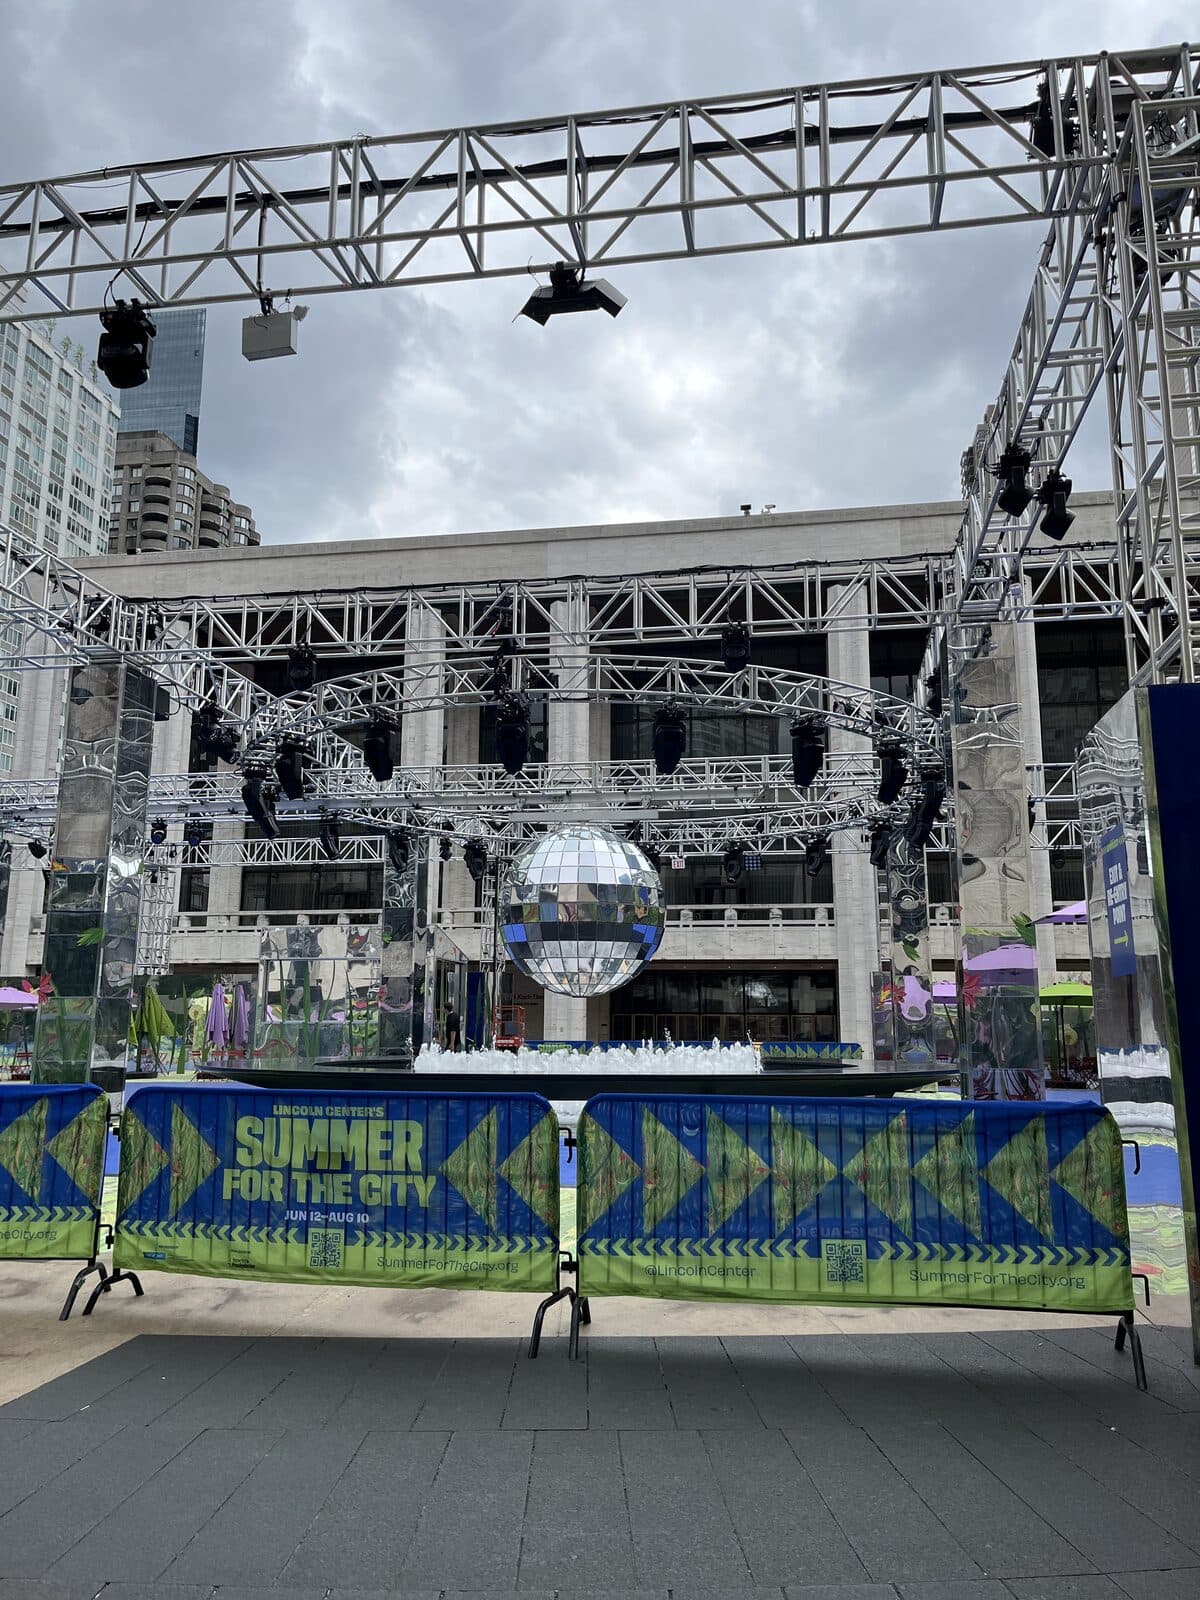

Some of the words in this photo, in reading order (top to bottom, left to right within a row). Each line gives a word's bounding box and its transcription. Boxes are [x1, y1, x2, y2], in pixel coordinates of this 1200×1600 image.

[673, 860, 684, 868] EXIT
[272, 1105, 323, 1117] LINCOLN
[325, 1106, 385, 1117] CENTER'S
[236, 1116, 423, 1171] SUMMER
[222, 1169, 283, 1201] FOR
[291, 1172, 352, 1204] THE
[359, 1174, 437, 1207] CITY
[284, 1210, 308, 1221] JUN
[356, 1213, 370, 1223] 10
[377, 1256, 519, 1273] SummerForTheCity.org
[645, 1264, 756, 1276] @LincolnCenter
[909, 1269, 1086, 1289] SummerForTheCity.org
